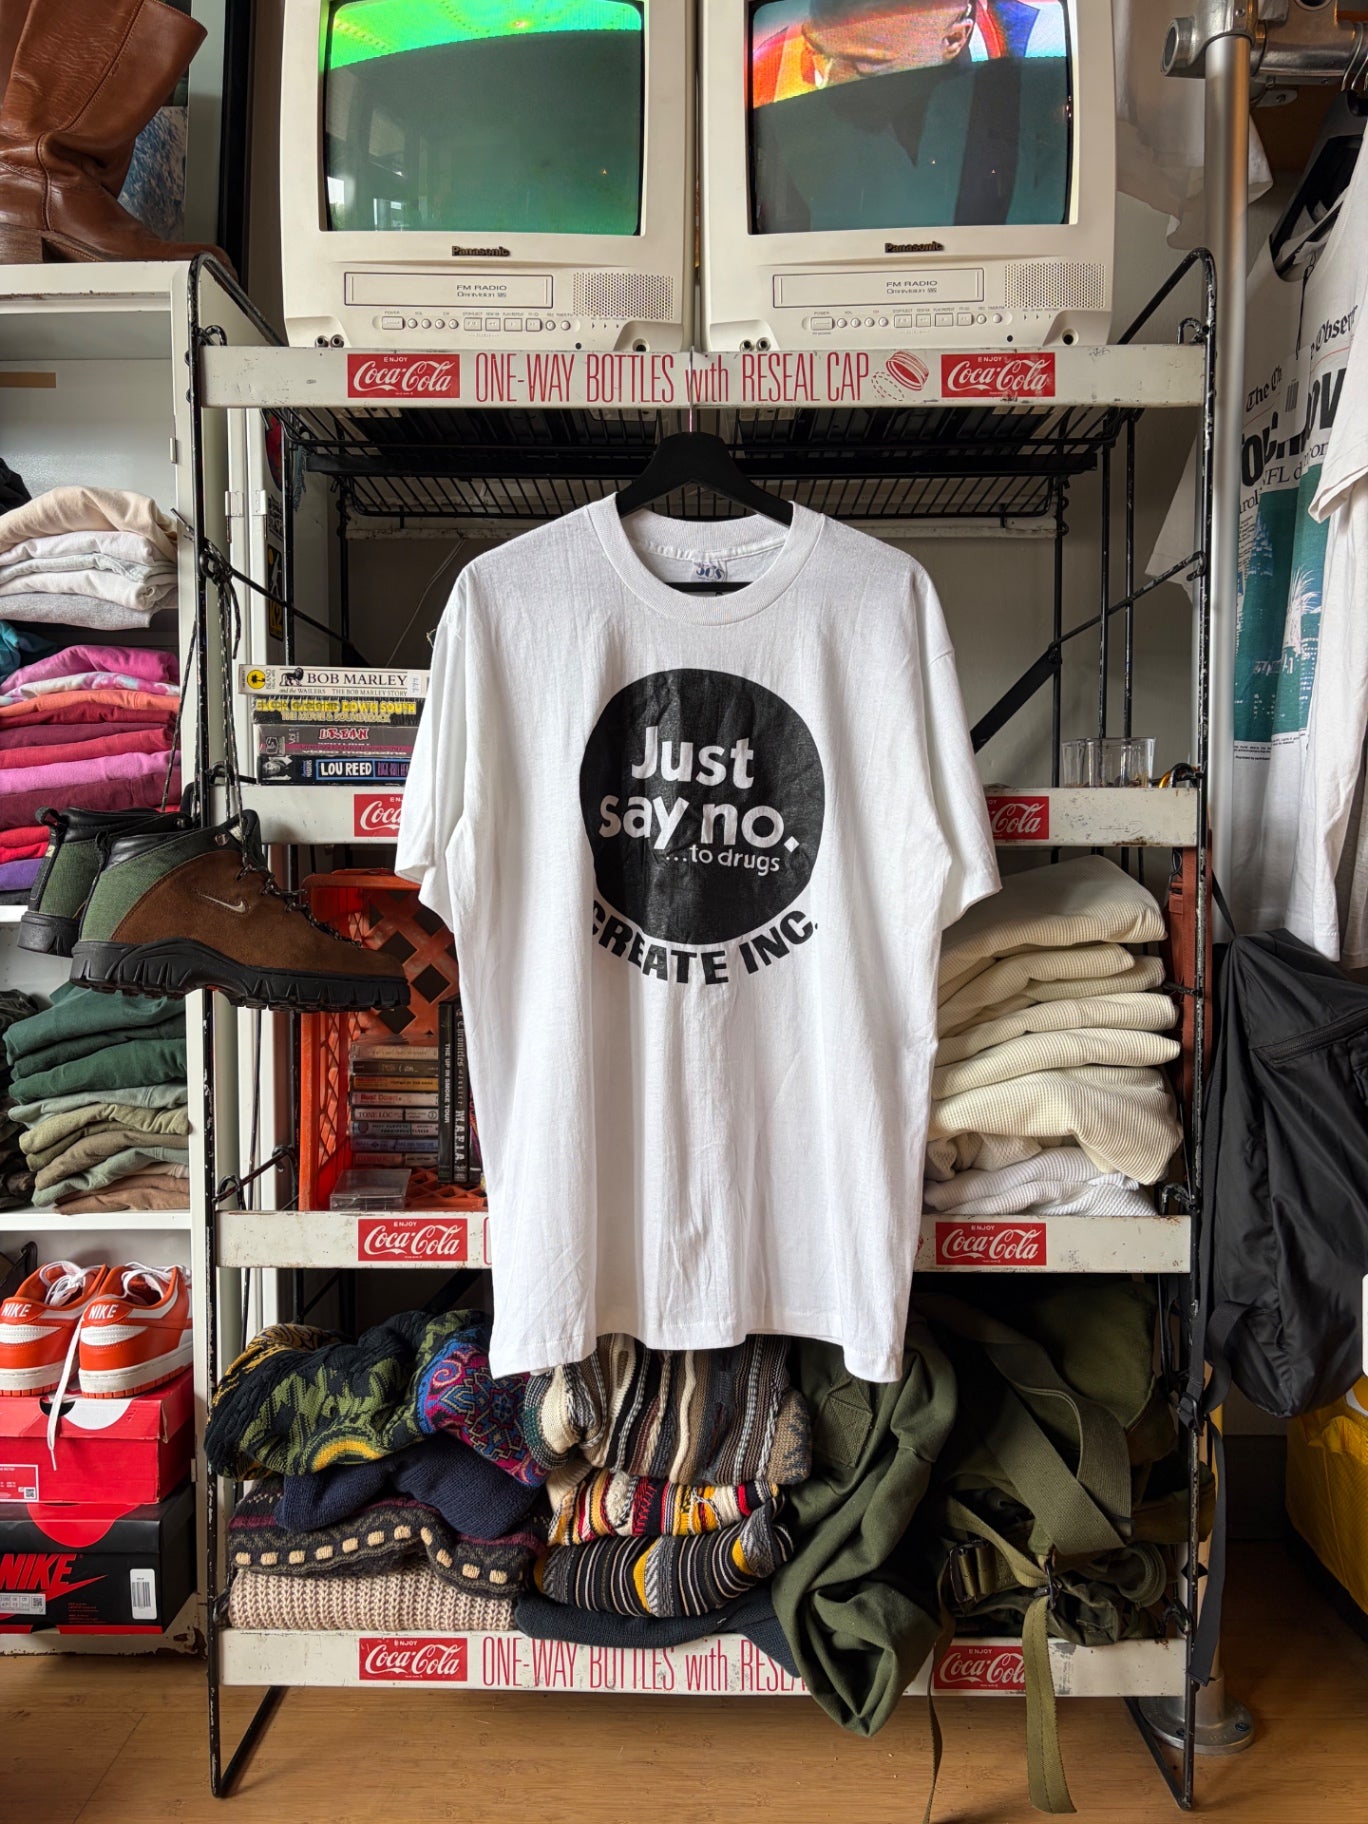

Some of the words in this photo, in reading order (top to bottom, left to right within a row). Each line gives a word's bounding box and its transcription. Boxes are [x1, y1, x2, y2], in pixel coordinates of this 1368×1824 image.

[452, 246, 511, 257] Panasonic
[885, 241, 944, 253] Panasonic
[353, 360, 456, 392] Coca-Cola
[475, 352, 575, 402] ONE-WAY
[586, 353, 674, 403] BOTTLES
[685, 354, 729, 402] with
[742, 352, 820, 402] RESEAL
[826, 351, 869, 402] CAP
[947, 359, 1052, 392] Coca-Cola
[1246, 383, 1270, 413] The
[307, 672, 340, 684] BOB
[343, 673, 408, 686] MARLEY
[380, 701, 417, 715] SOUTH
[320, 761, 343, 776] LOU
[345, 761, 373, 776] REED
[631, 725, 755, 790] Just
[598, 794, 690, 850] say
[700, 802, 800, 854] no.
[717, 848, 780, 876] drugs
[592, 900, 729, 985] CREATE
[739, 910, 818, 975] INC.
[443, 1104, 451, 1124] TOUR
[363, 1225, 464, 1255] Coca-Cola
[941, 1228, 1042, 1260] Coca-Cola
[1, 1302, 32, 1318] NIKE
[88, 1303, 119, 1319] NIKE
[0, 1553, 77, 1590] NIKE
[393, 1639, 418, 1647] ENJOY
[364, 1641, 464, 1676] Coca-Cola
[482, 1636, 578, 1688] ONE-WAY
[589, 1646, 675, 1691] BOTTLES
[685, 1638, 728, 1692] with
[939, 1652, 1026, 1684] Coca-Col
